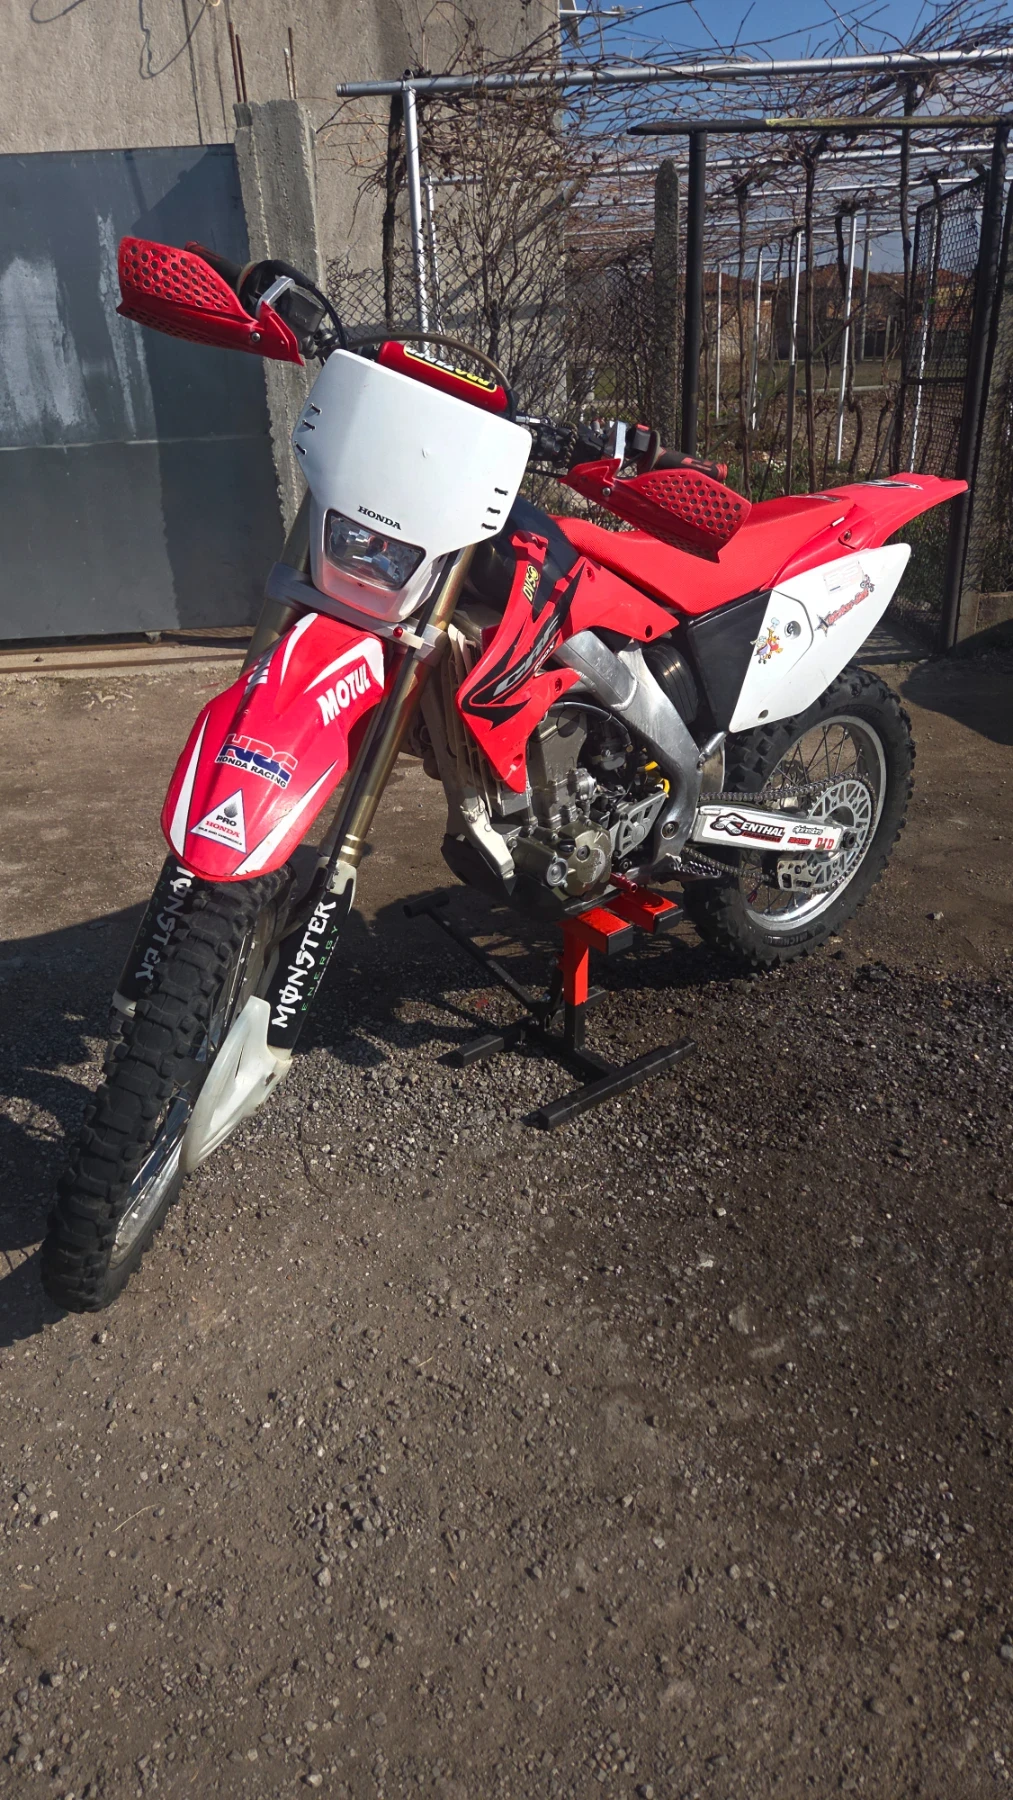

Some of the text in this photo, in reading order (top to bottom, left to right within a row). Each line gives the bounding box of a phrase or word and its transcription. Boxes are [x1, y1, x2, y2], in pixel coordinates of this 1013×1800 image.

[357, 504, 402, 530] HONDA
[316, 662, 371, 727] MOTUL
[216, 755, 287, 788] HONDA RACING
[205, 820, 241, 838] HONDA
[216, 814, 237, 827] PRO
[271, 901, 337, 1029] MONSTER
[301, 925, 339, 1011] ENERGY
